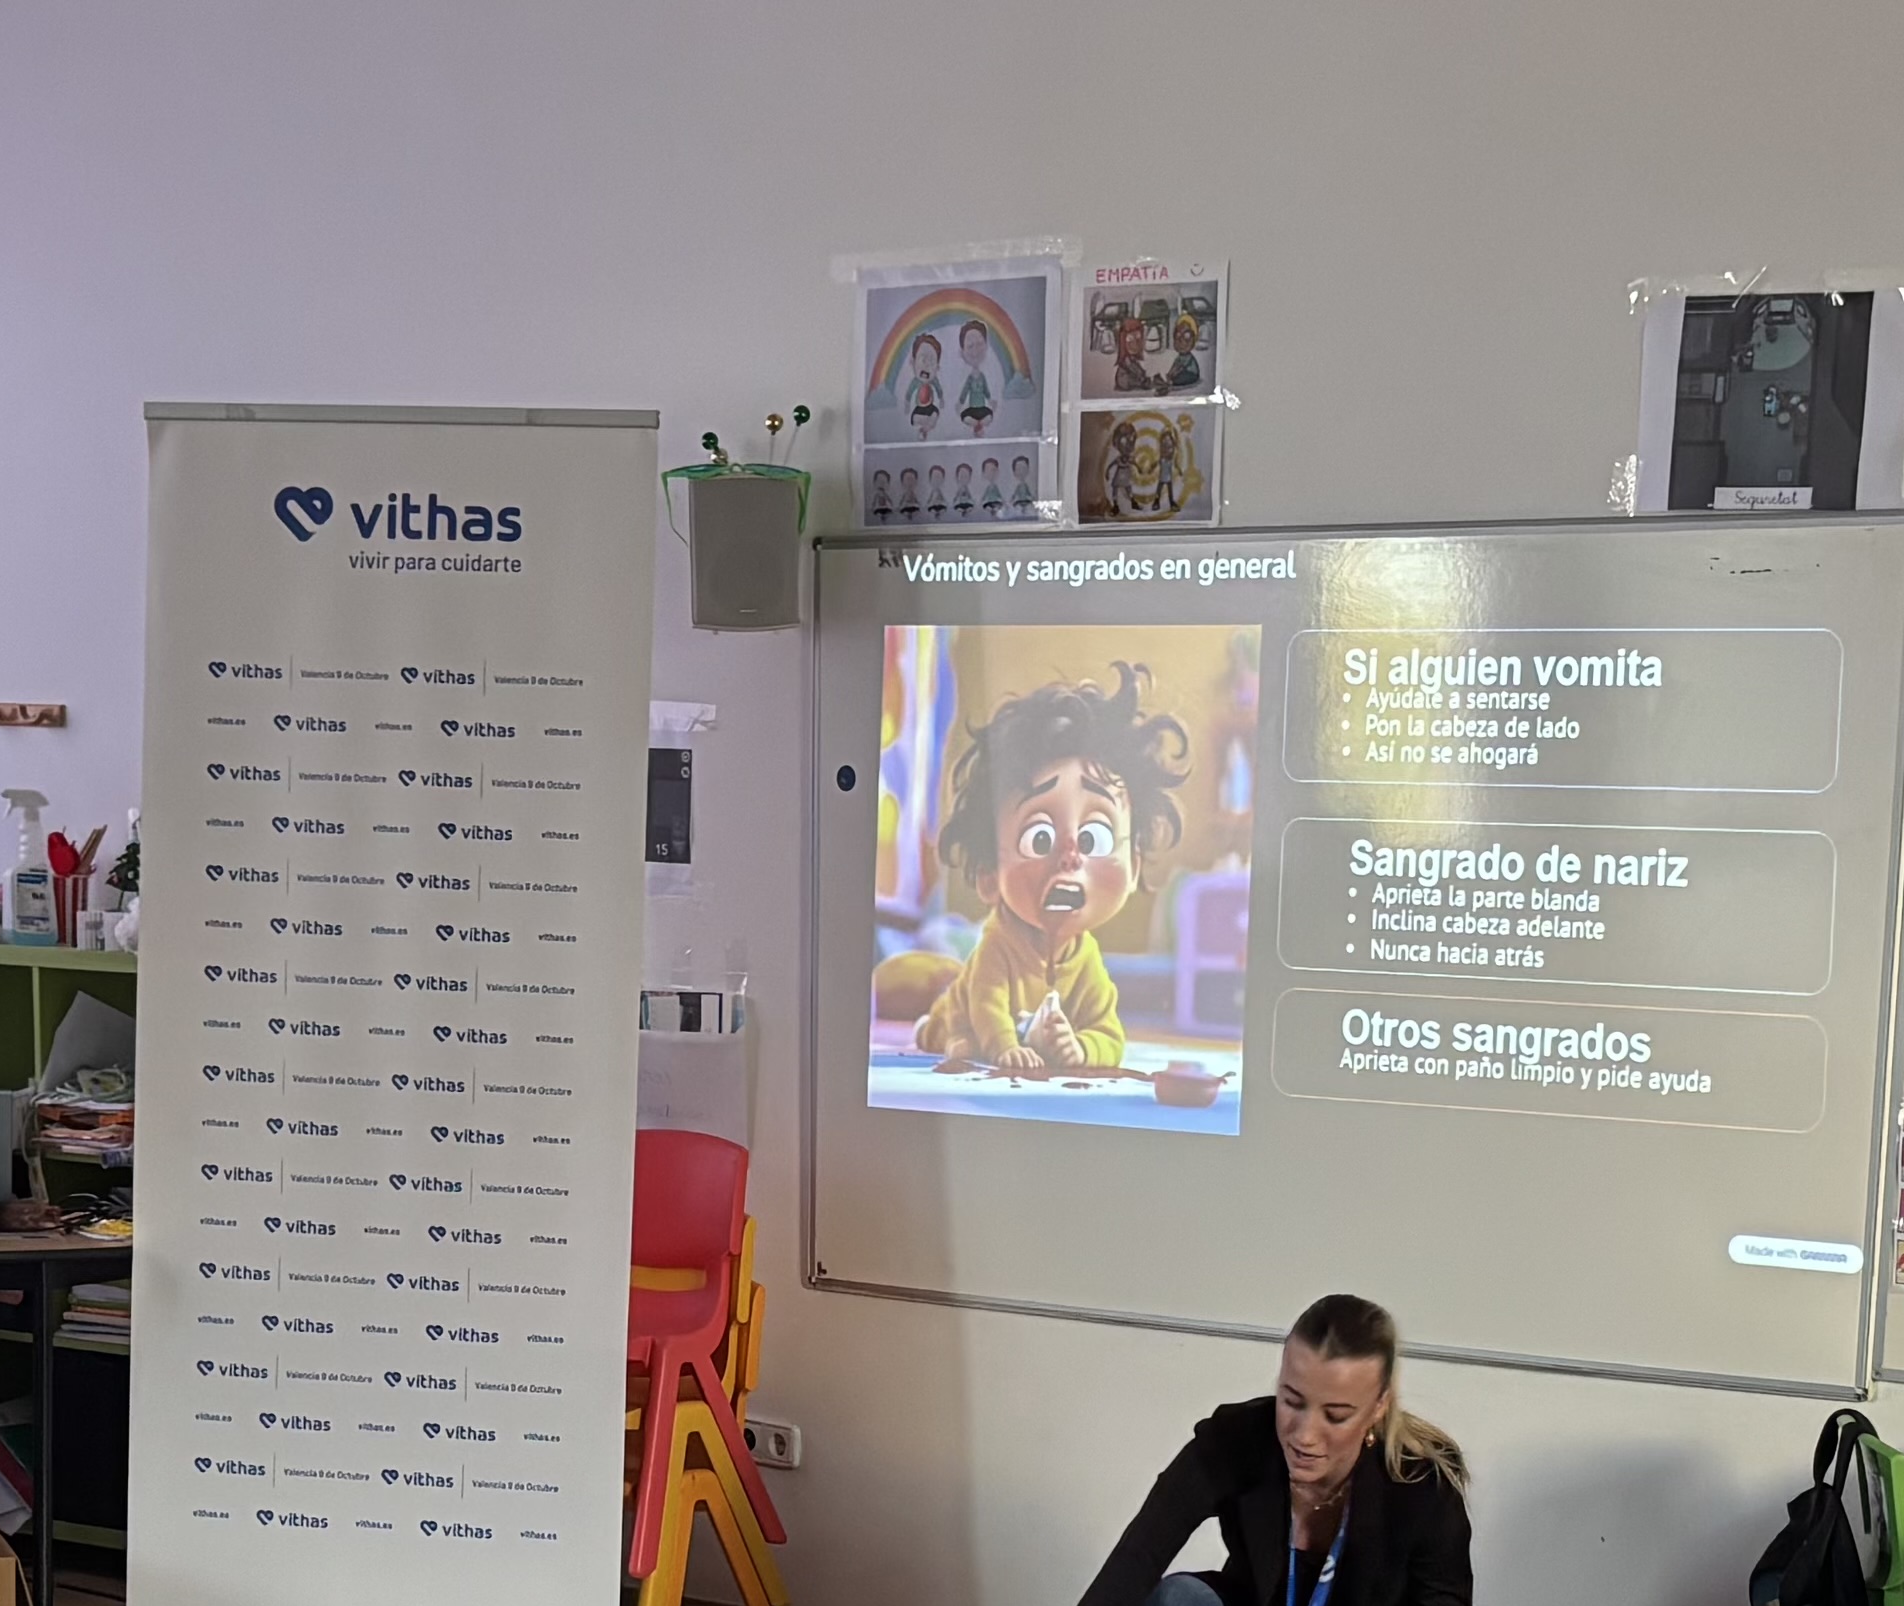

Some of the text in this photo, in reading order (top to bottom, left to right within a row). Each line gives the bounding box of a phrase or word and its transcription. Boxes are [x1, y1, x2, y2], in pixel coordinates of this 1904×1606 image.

[350, 492, 522, 543] vithas
[349, 550, 522, 575] vivir para cuidarte
[903, 550, 1296, 587] Vómitos y sangrados en general
[230, 663, 283, 680] vithas
[422, 668, 476, 686] vithas
[1344, 648, 1663, 694] Si alguien vomita
[1366, 687, 1551, 713] Ayúdale a sentarse
[295, 716, 348, 733] vithas
[462, 721, 516, 739] vithas
[1366, 714, 1581, 739] Pon la cabeza de lado
[1365, 741, 1539, 770] Así no se ahogará
[229, 765, 282, 782] vithas
[419, 771, 473, 789] vithas
[293, 818, 346, 835] vithas
[460, 824, 513, 842] vithas
[655, 844, 669, 856] 15
[1349, 838, 1689, 888] Sangrado de nariz
[227, 866, 280, 884] vithas
[417, 874, 471, 891] vithas
[1372, 882, 1600, 912] Aprieta la parte blanda
[291, 919, 344, 937] vithas
[1372, 908, 1606, 940] Inclina cabeza adelante
[458, 926, 511, 944] vithas
[1370, 938, 1545, 968] Nunca hacia atrás
[226, 967, 278, 984] vithas
[415, 975, 469, 993] vithas
[289, 1020, 341, 1037] vithas
[455, 1027, 508, 1045] vithas
[1342, 1008, 1652, 1063] Otros sangrados
[224, 1067, 276, 1084] vithas
[1339, 1047, 1712, 1096] Aprieta con paño limpio y pide ayuda
[412, 1076, 466, 1093] vithas
[287, 1120, 339, 1137] vithas
[452, 1128, 505, 1146] vithas
[223, 1165, 274, 1183] vithas
[410, 1176, 463, 1193] vithas
[284, 1219, 337, 1237] vithas
[450, 1228, 503, 1245] vithas
[220, 1264, 271, 1282] vithas
[407, 1275, 460, 1292] vithas
[282, 1317, 334, 1335] vithas
[447, 1326, 500, 1344] vithas
[218, 1362, 269, 1380] vithas
[405, 1373, 457, 1391] vithas
[280, 1415, 332, 1432] vithas
[444, 1425, 497, 1442] vithas
[215, 1459, 267, 1477] vithas
[402, 1471, 455, 1489] vithas
[277, 1512, 329, 1529] vithas
[441, 1522, 493, 1540] vithas
